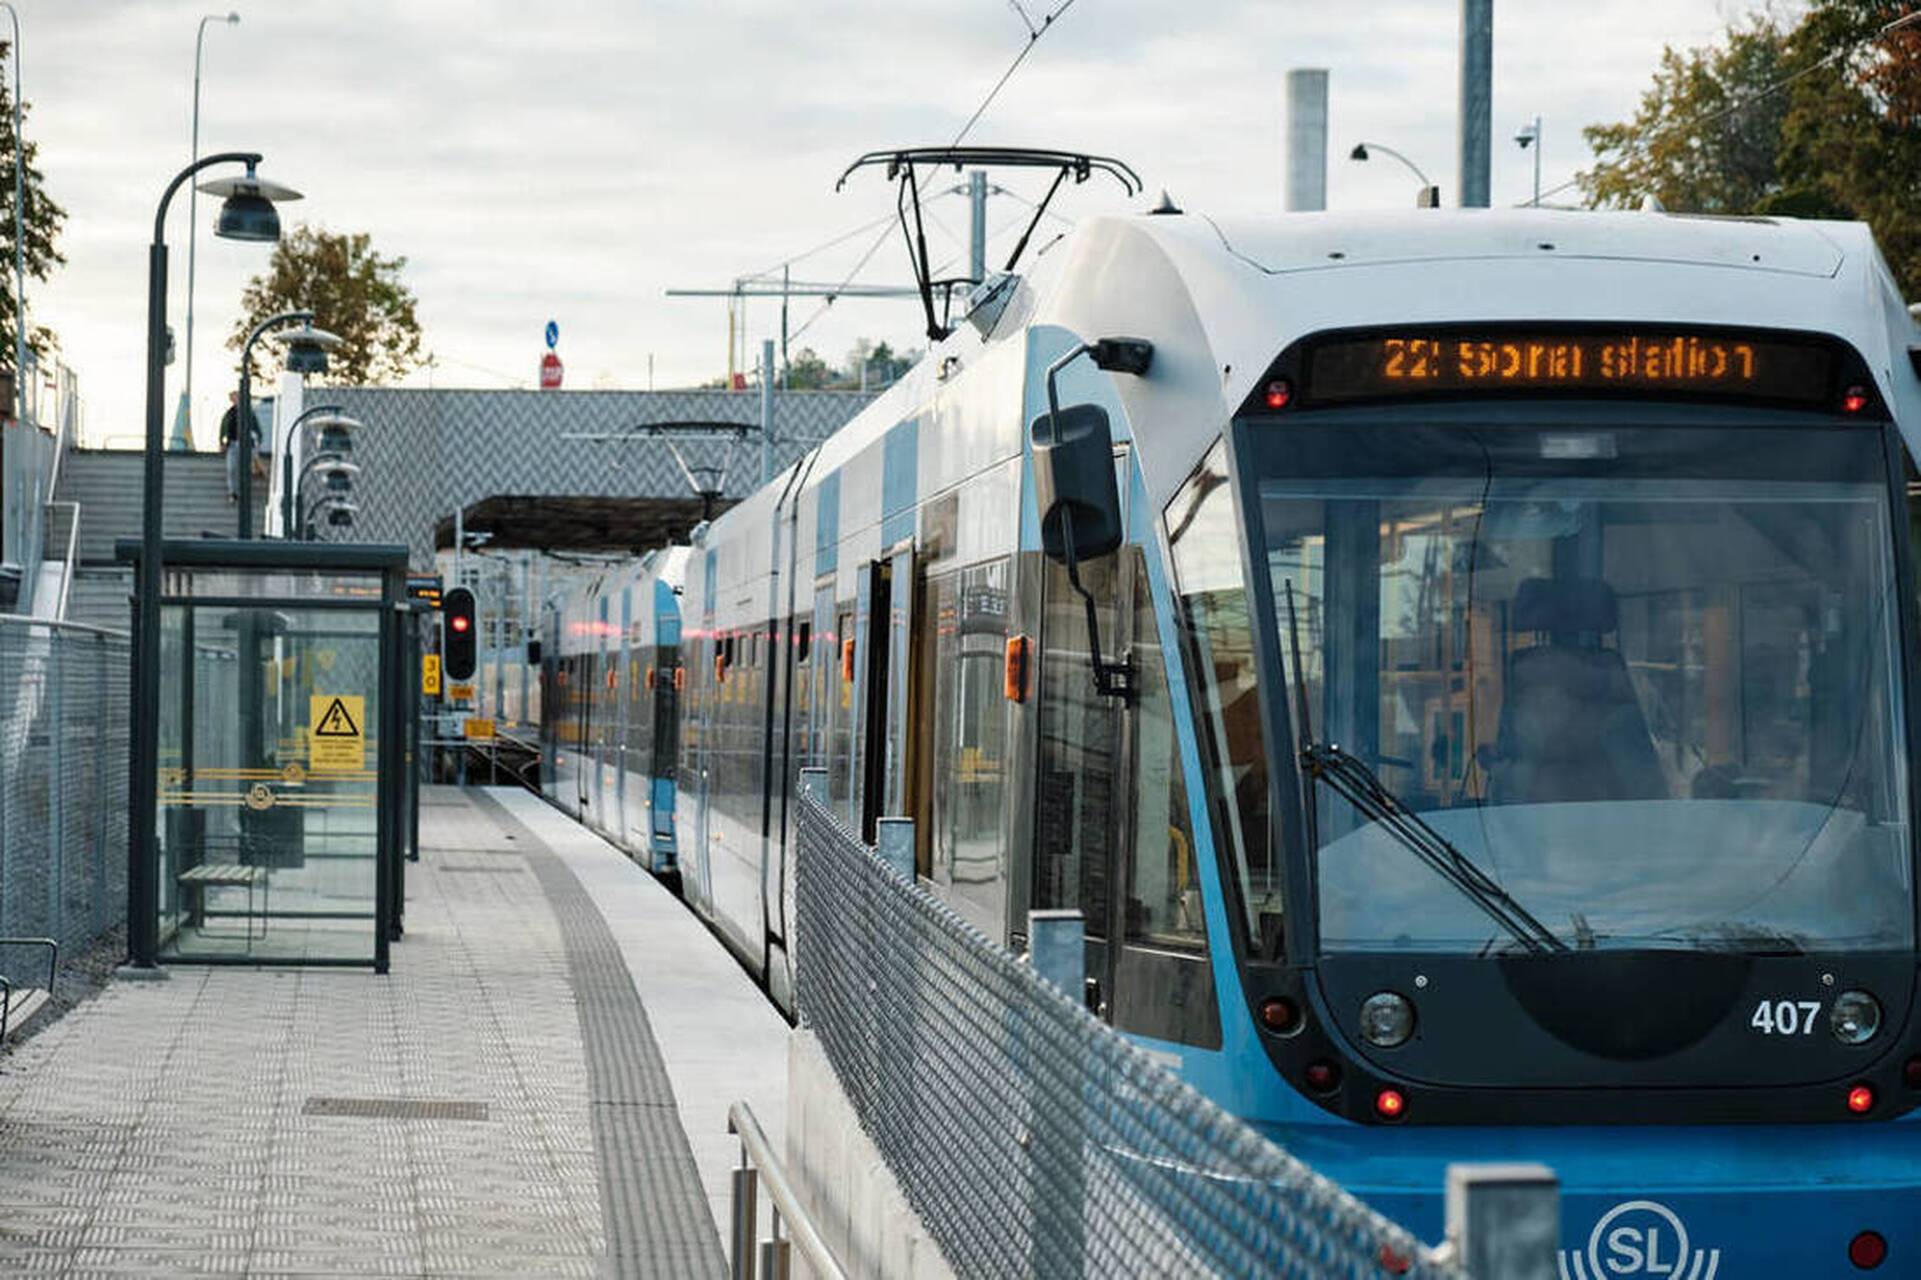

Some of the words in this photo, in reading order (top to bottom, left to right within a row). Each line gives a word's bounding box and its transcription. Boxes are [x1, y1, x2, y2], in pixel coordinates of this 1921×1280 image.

[1458, 341, 1581, 378] Sona
[1600, 336, 1755, 379] station
[1751, 1000, 1821, 1036] 407
[1605, 1226, 1673, 1275] SL
